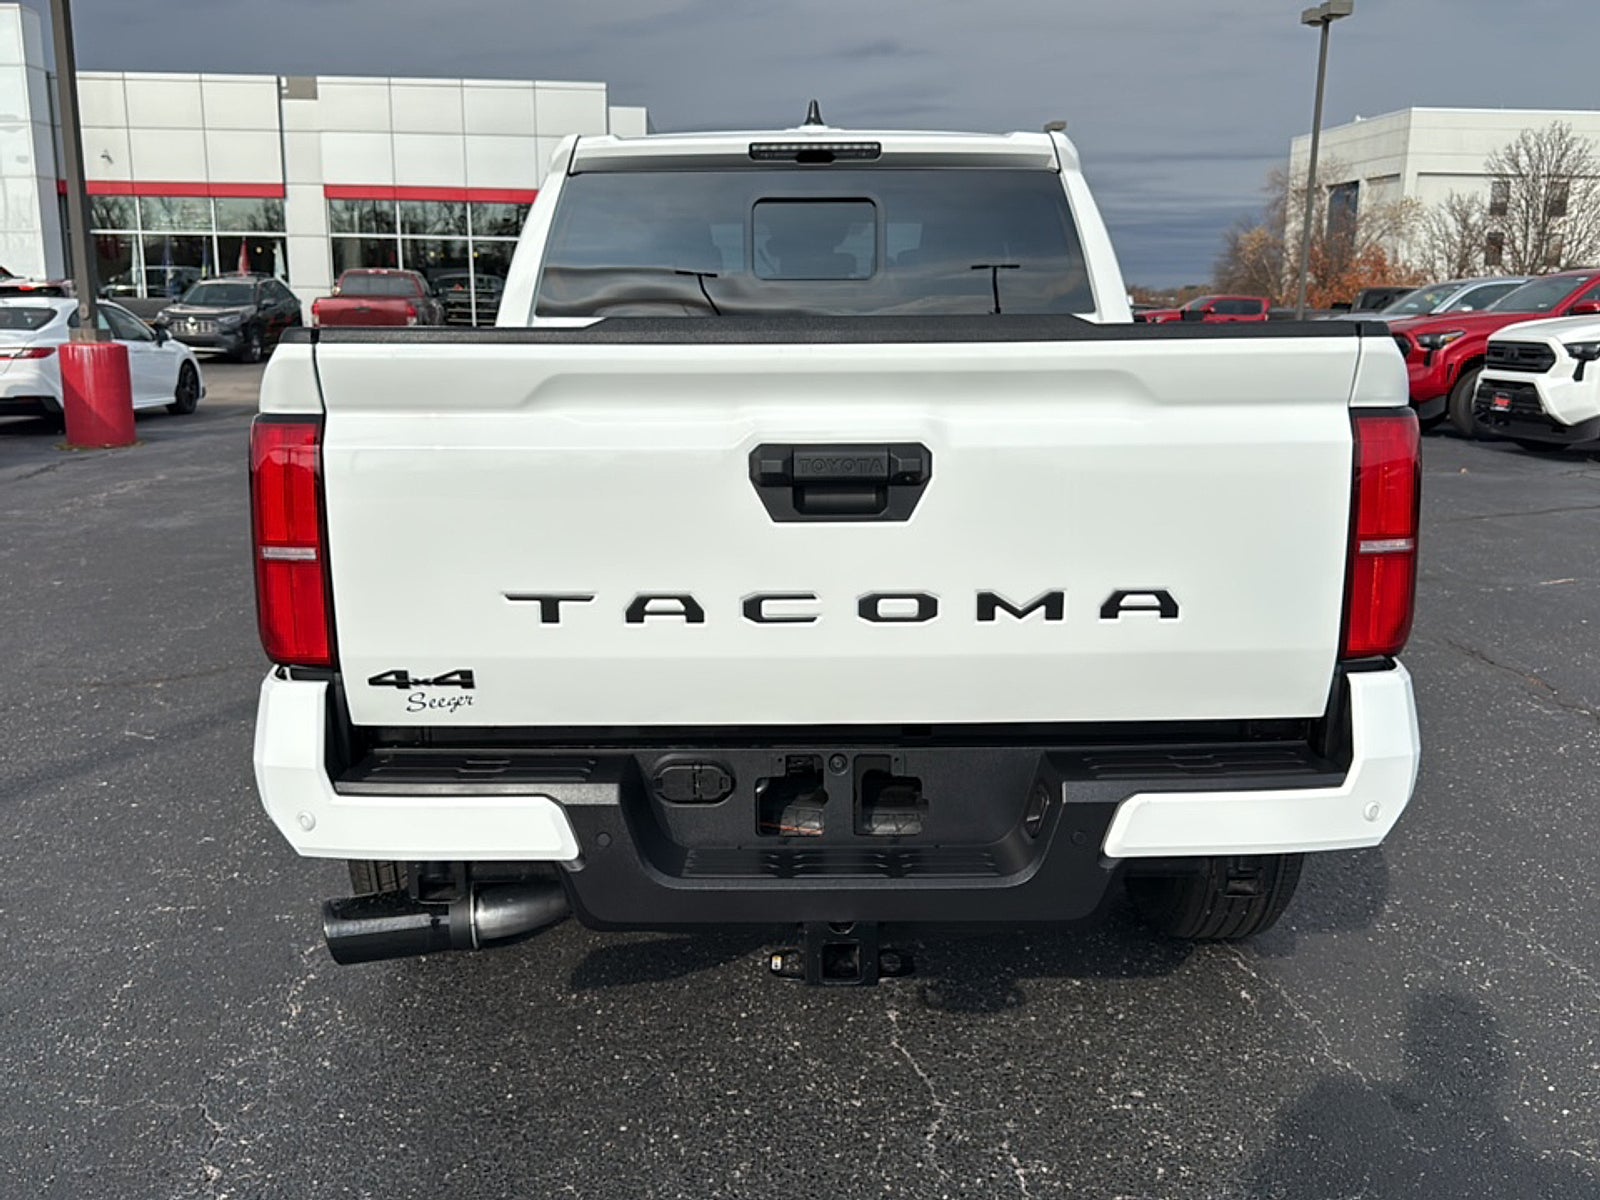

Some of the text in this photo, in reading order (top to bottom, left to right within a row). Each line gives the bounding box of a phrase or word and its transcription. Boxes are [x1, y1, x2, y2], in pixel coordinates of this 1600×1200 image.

[799, 457, 885, 474] TOYOTA
[504, 589, 1180, 623] TACOMA
[406, 691, 473, 713] Seeger
